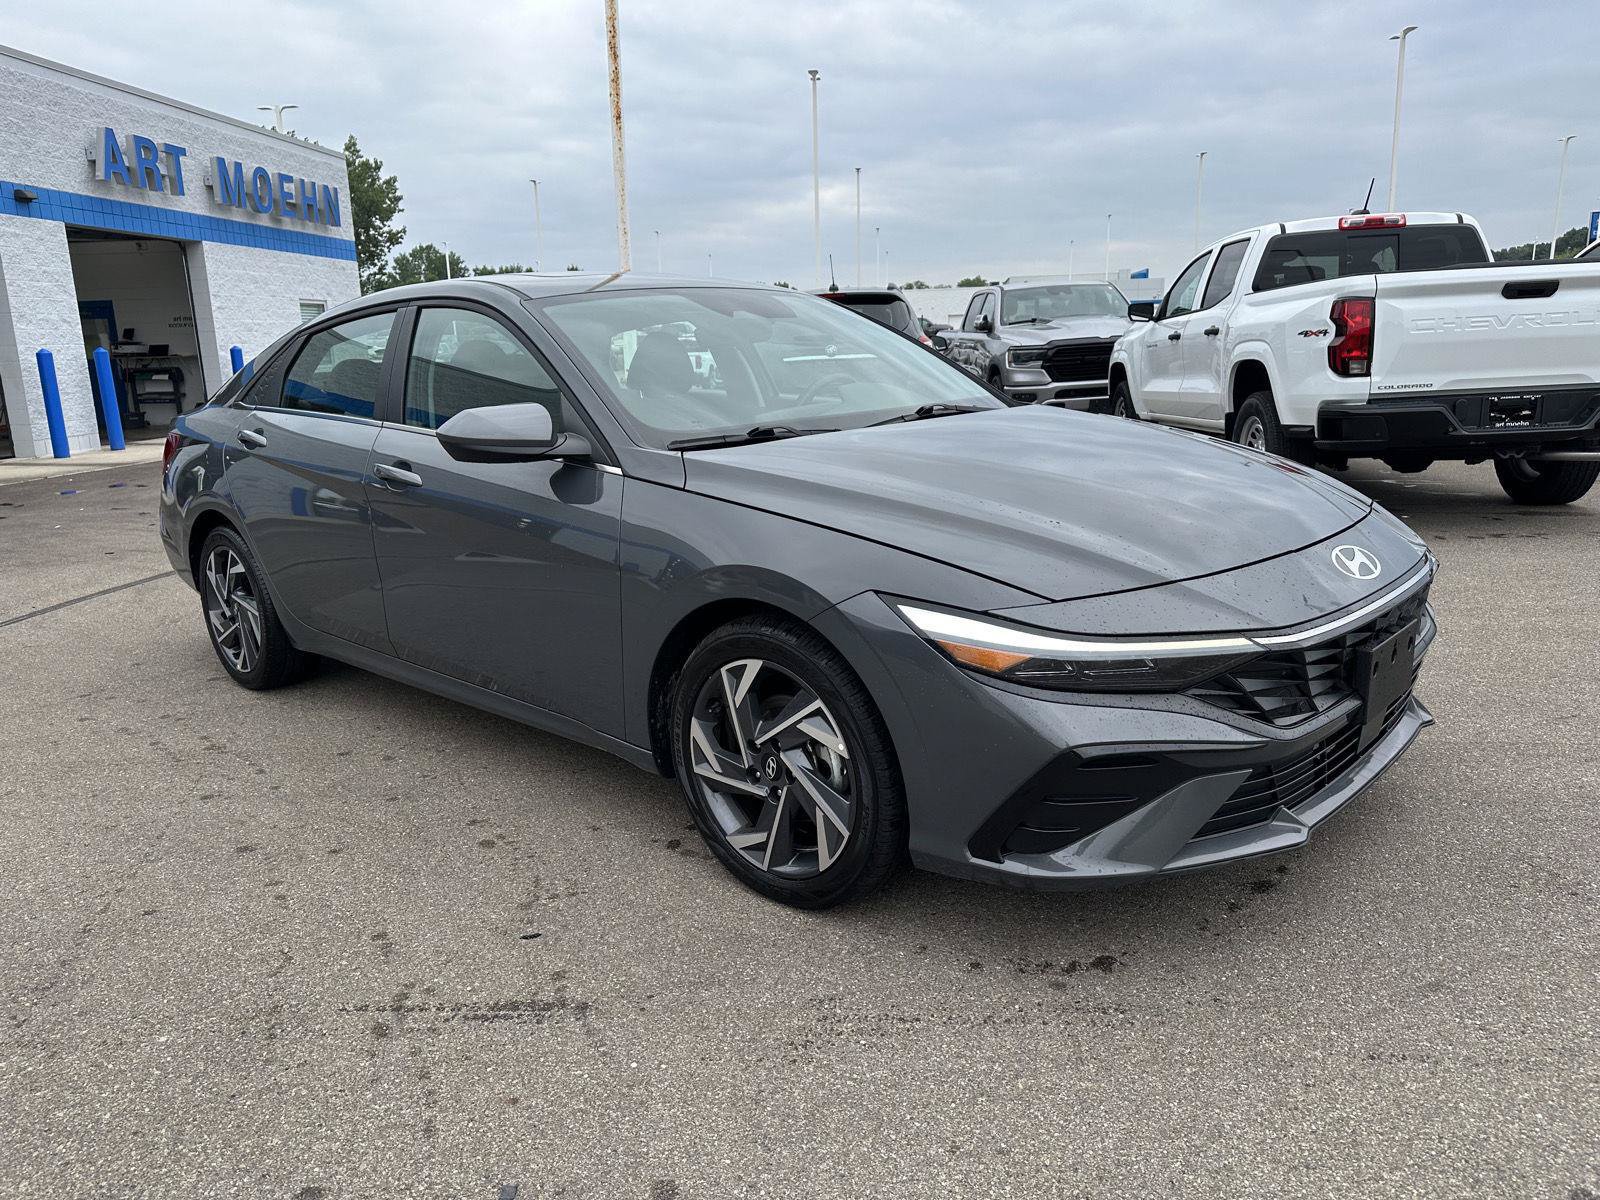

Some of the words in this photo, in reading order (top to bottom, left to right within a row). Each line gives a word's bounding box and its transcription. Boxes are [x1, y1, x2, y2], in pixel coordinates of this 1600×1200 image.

[96, 127, 187, 196] ART
[211, 156, 342, 227] MOEHN
[1410, 310, 1600, 333] CHEVROL
